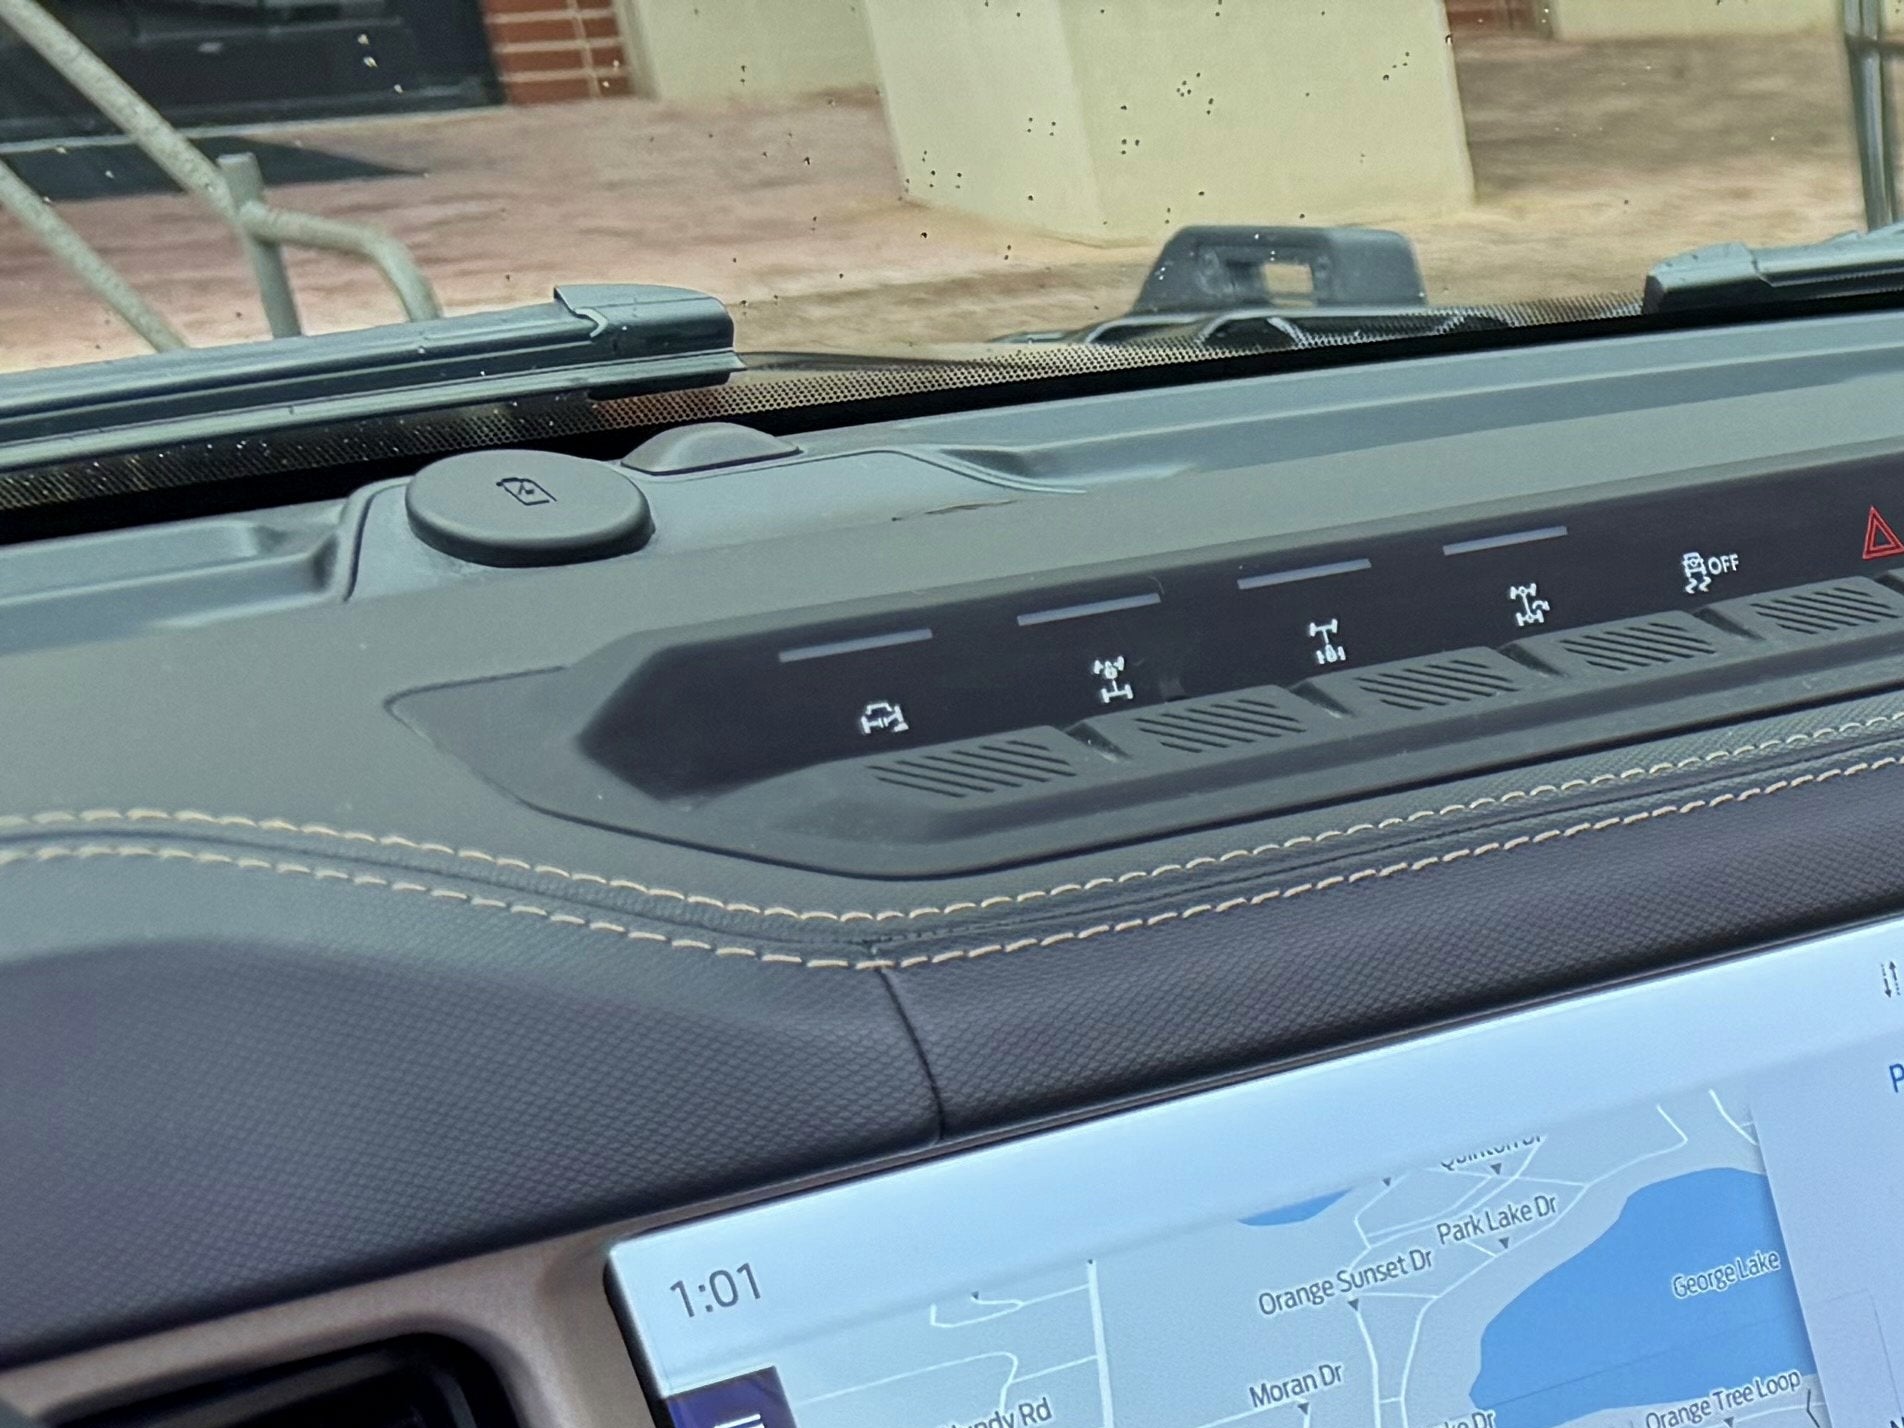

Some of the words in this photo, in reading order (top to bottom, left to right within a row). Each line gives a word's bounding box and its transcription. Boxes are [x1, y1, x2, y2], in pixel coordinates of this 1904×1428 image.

[1707, 553, 1740, 576] OFF
[1437, 1217, 1480, 1246] Park
[1481, 1203, 1531, 1234] Lake
[1531, 1195, 1557, 1220] Dr
[668, 1262, 763, 1320] 1:01
[1259, 1277, 1334, 1316] Orange
[1337, 1256, 1404, 1293] Sunset
[1404, 1249, 1433, 1273] Dr
[1673, 1266, 1737, 1299] George
[1736, 1251, 1780, 1280] Lake
[1250, 1372, 1317, 1408] Moran
[1319, 1363, 1344, 1387] Dr
[1714, 1387, 1754, 1415] Tree
[1754, 1371, 1802, 1405] Loop
[1019, 1399, 1052, 1427] Rd
